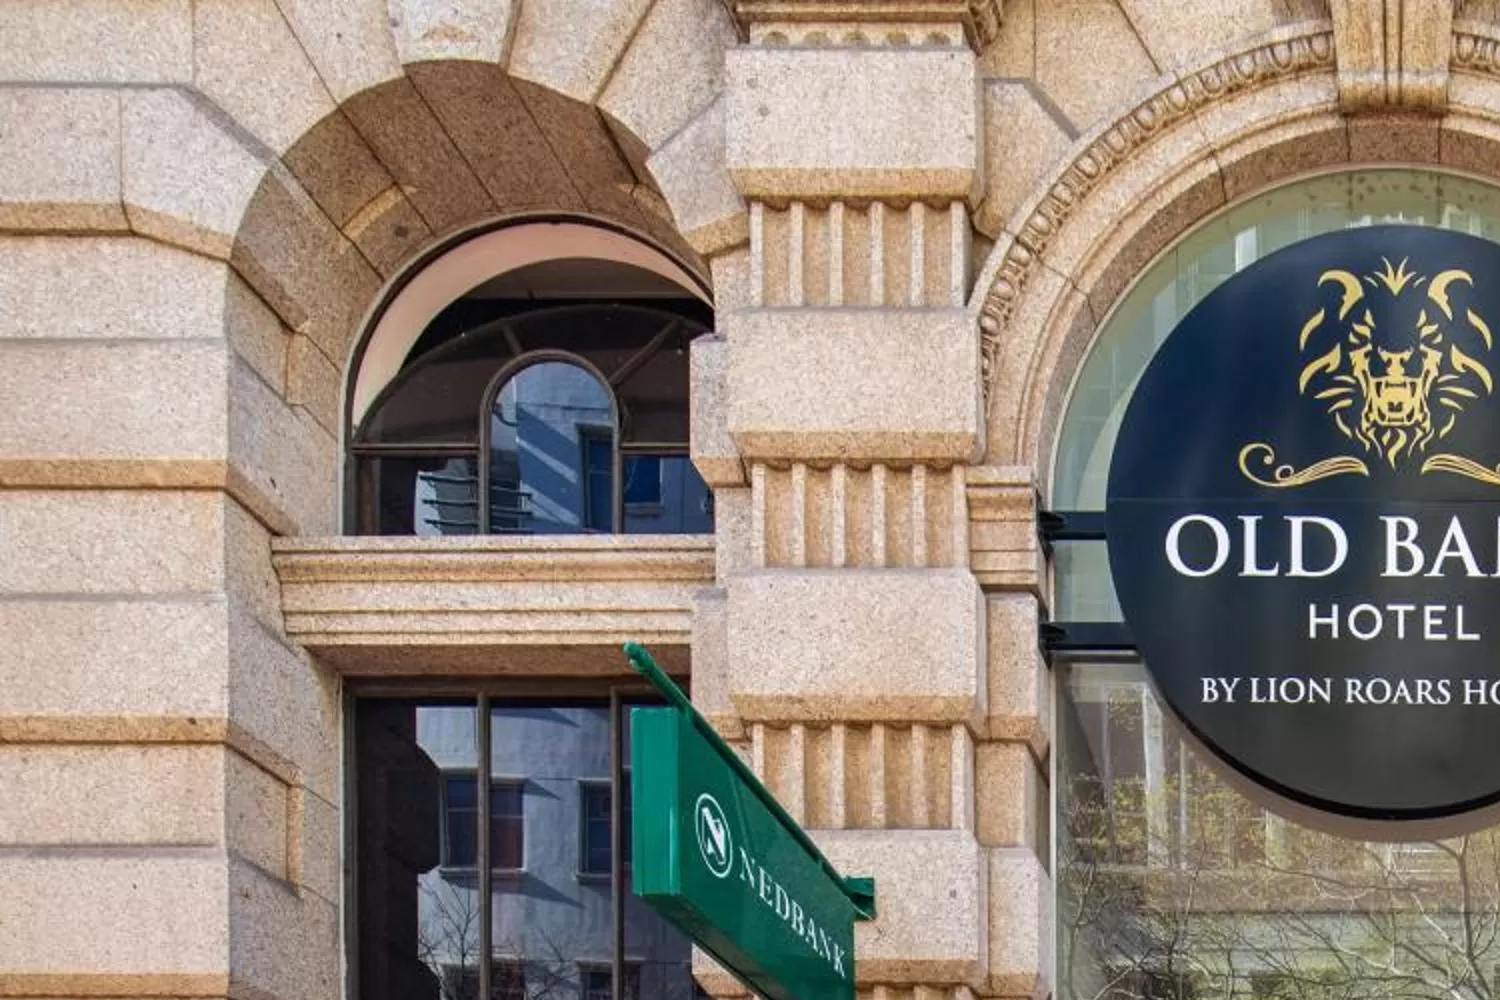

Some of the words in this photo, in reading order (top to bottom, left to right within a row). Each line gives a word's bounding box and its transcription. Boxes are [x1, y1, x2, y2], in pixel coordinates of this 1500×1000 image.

[1165, 514, 1350, 579] OLD
[1309, 603, 1482, 642] HOTEL
[1201, 677, 1243, 705] BY
[1250, 677, 1333, 705] LION
[1345, 678, 1453, 706] ROARS
[739, 845, 846, 978] NEDBANK
